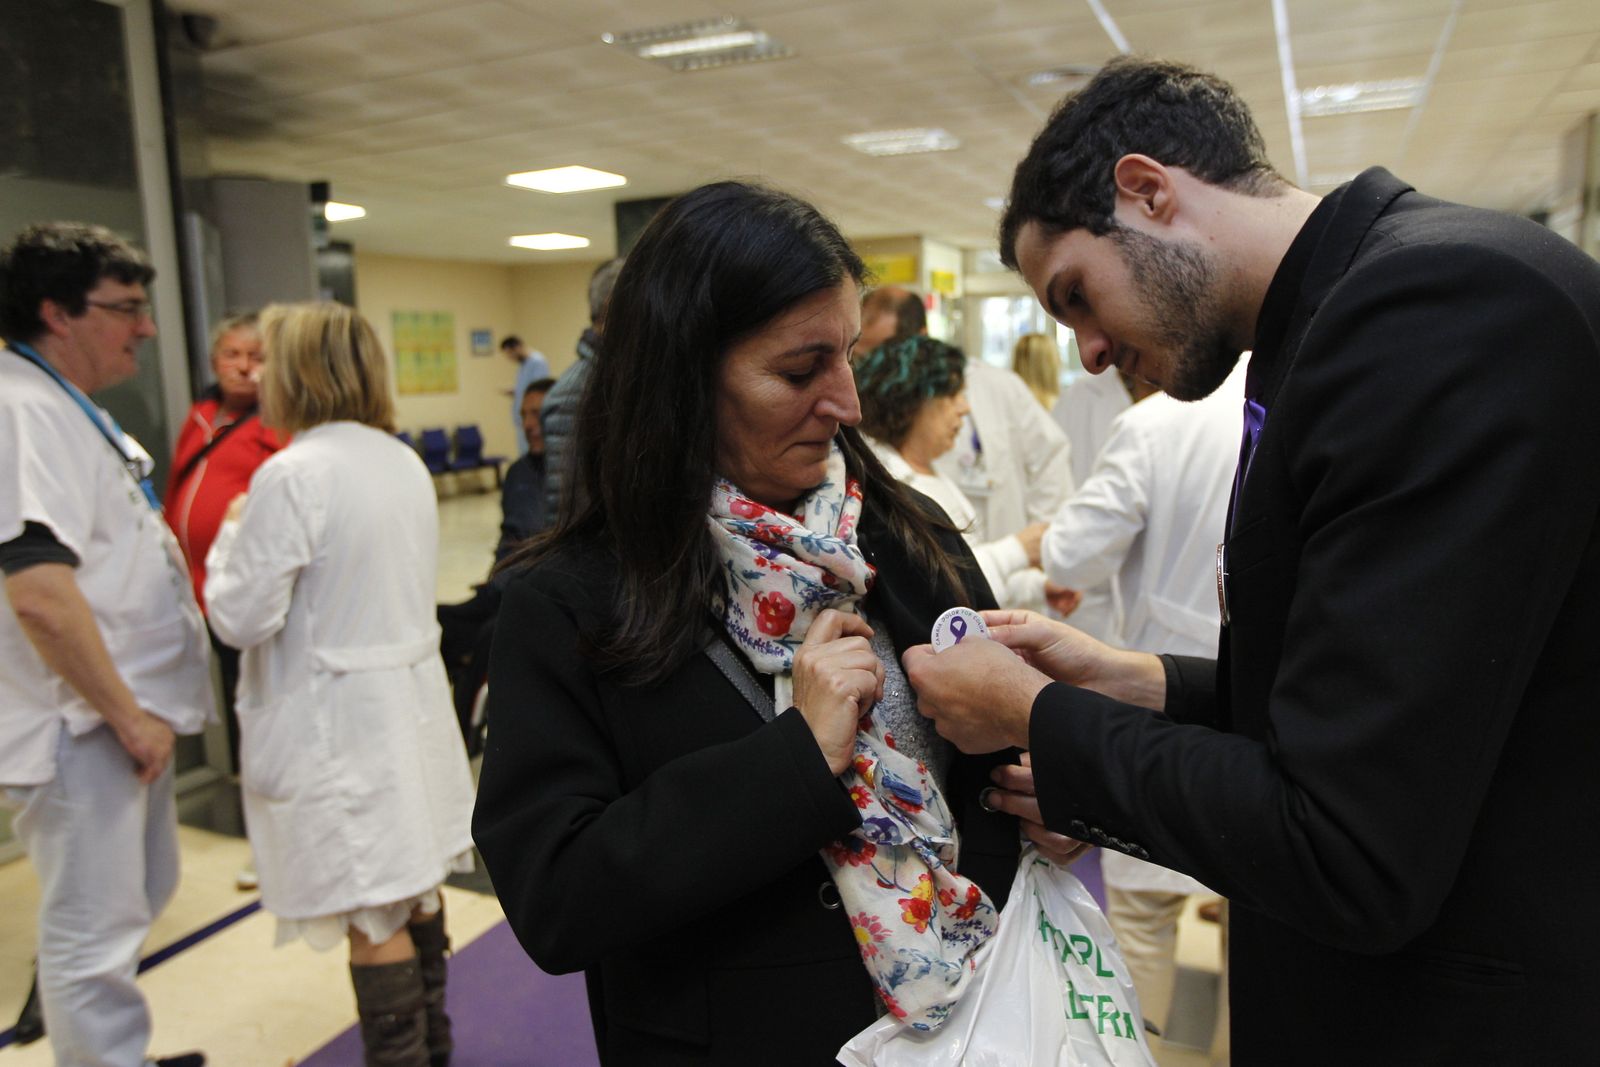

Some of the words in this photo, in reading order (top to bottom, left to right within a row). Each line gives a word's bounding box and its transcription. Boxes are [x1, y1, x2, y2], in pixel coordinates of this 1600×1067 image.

[935, 623, 943, 646] CAMBIA
[941, 610, 960, 623] DOLOR
[972, 615, 985, 634] COLOR
